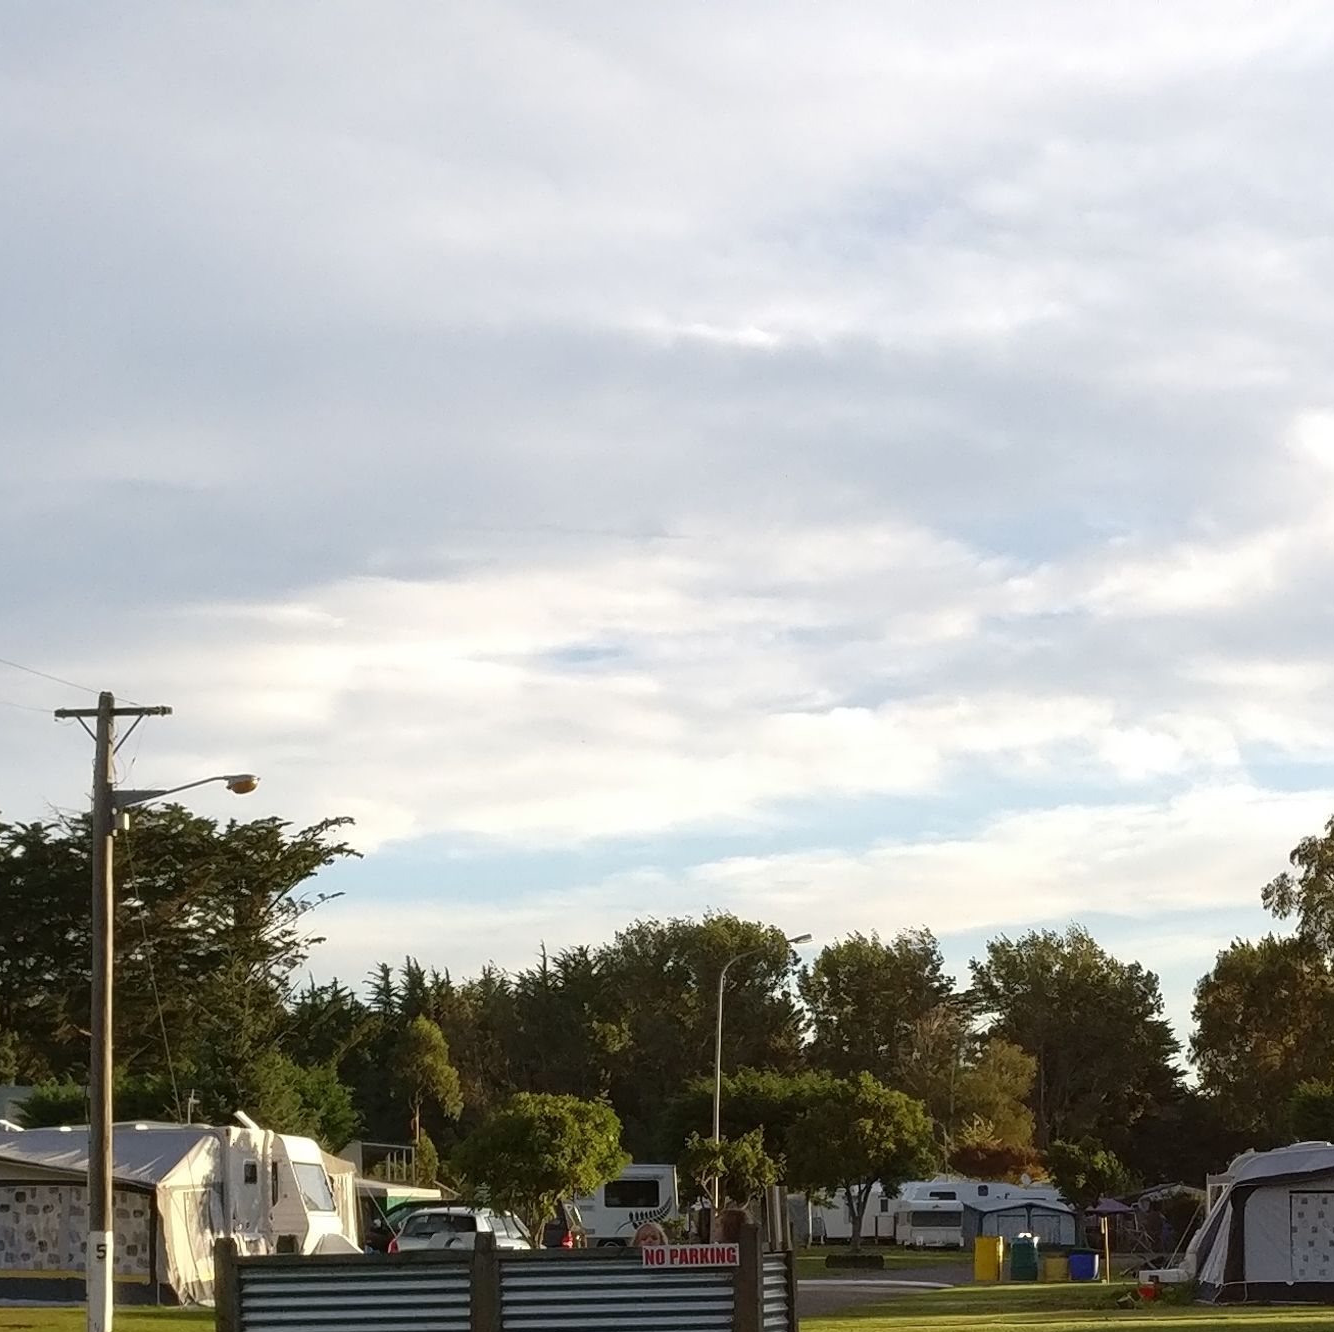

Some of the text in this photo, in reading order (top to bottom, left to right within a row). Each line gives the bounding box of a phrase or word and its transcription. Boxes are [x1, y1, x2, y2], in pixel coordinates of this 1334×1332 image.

[96, 1243, 107, 1260] 5
[644, 1247, 738, 1266] NO PARKING
